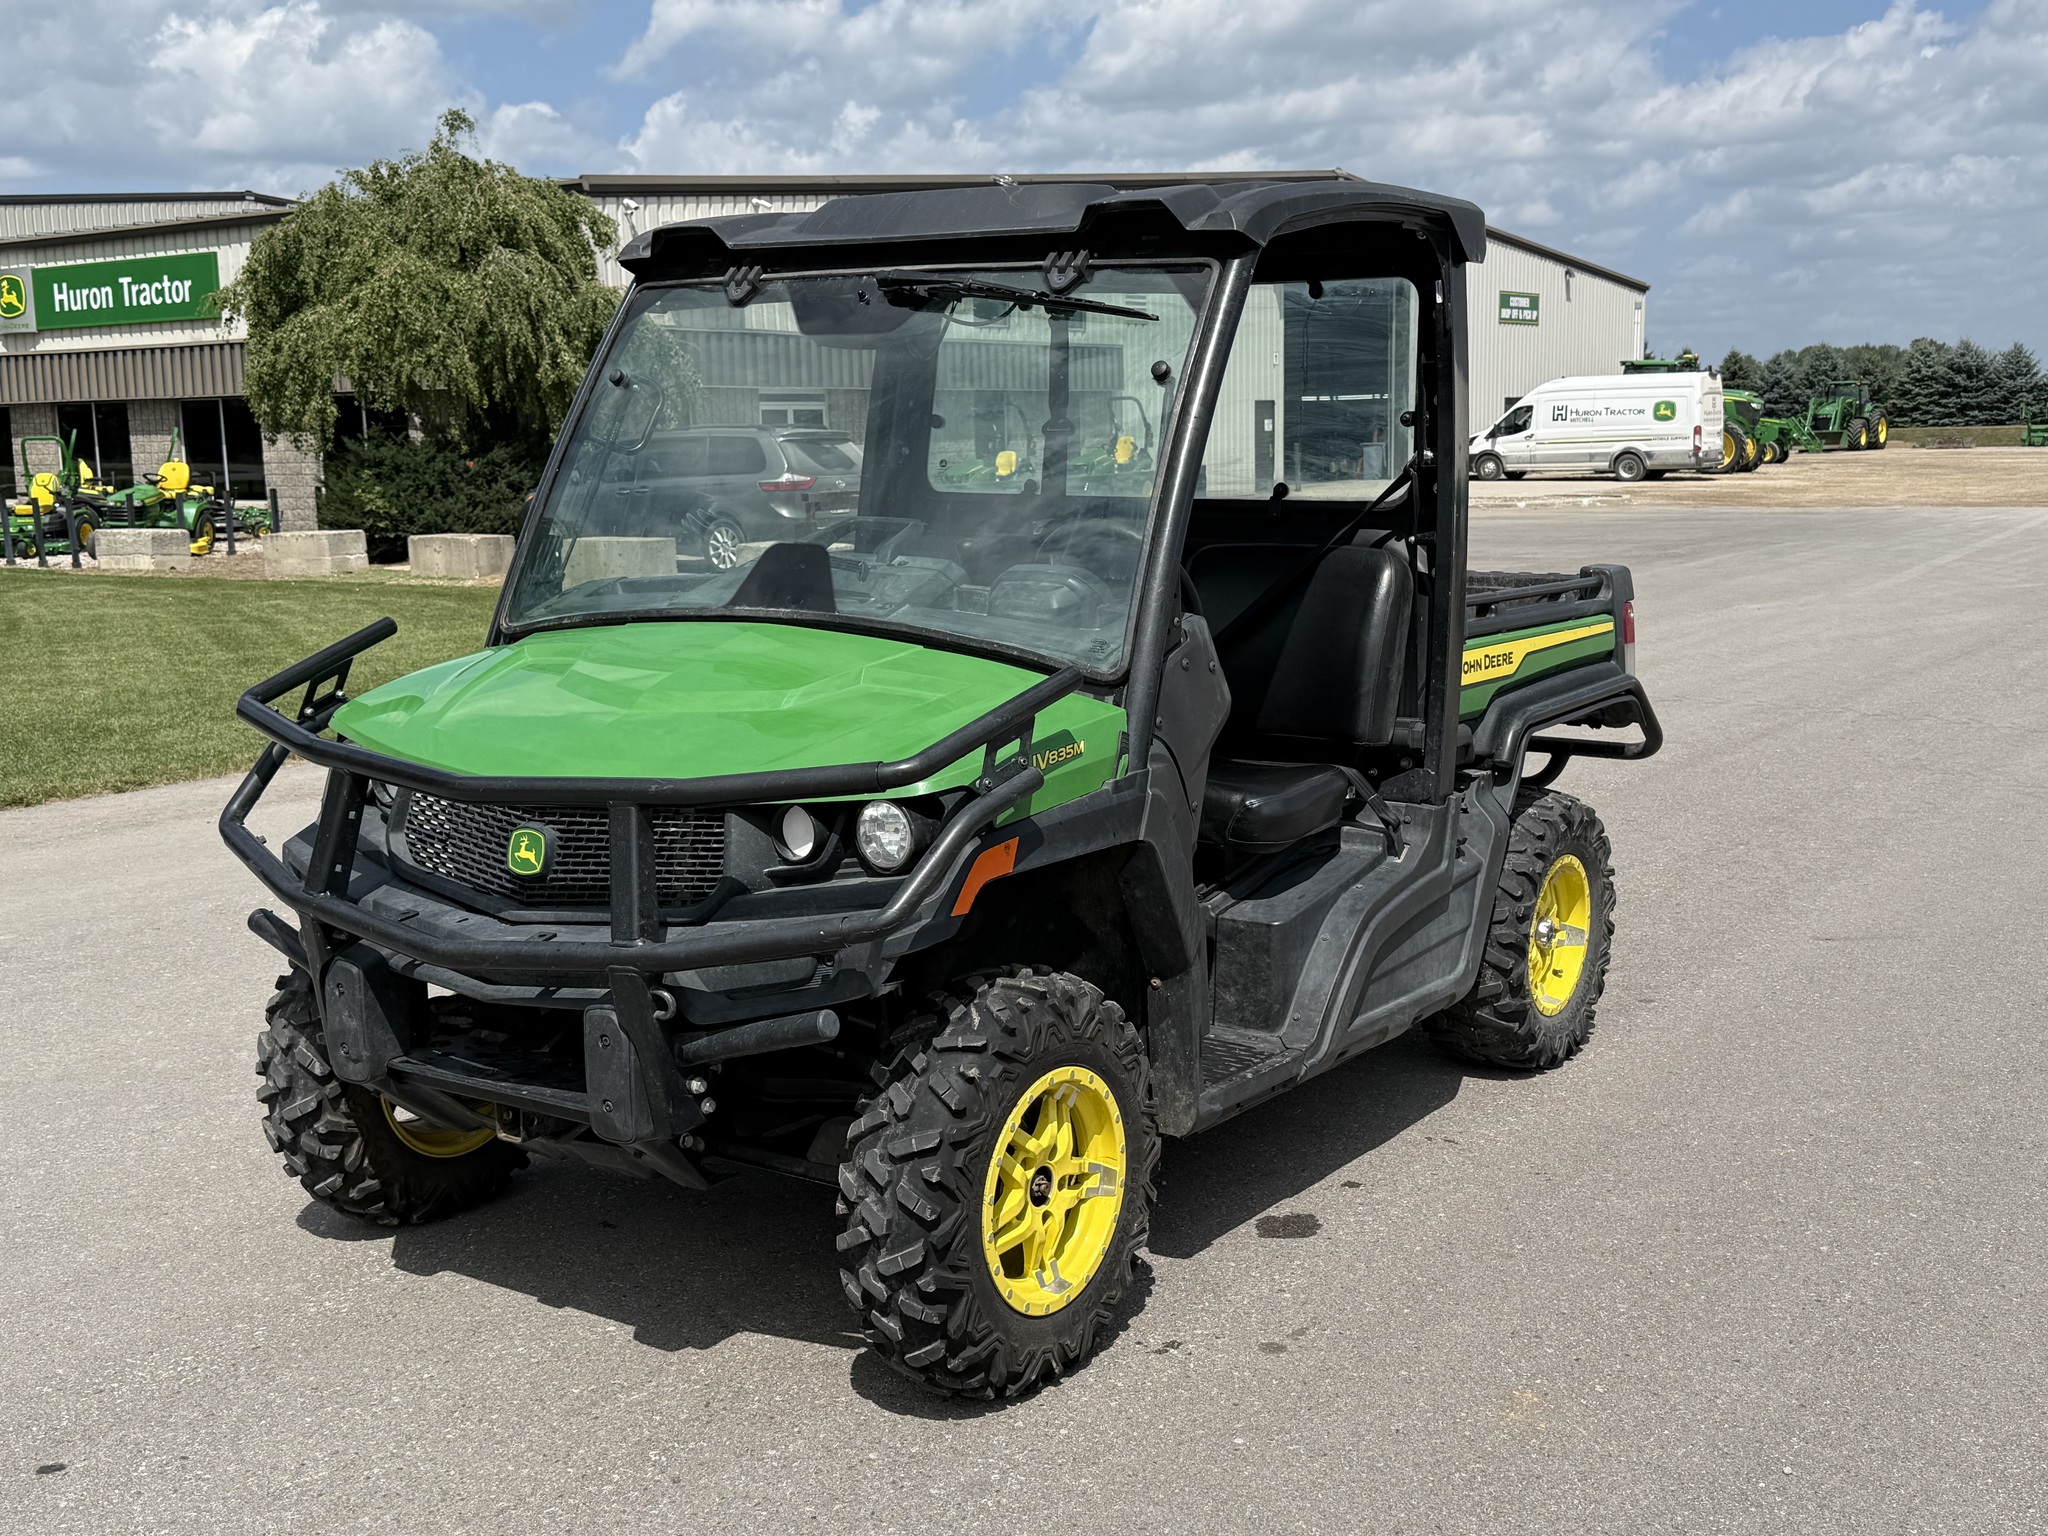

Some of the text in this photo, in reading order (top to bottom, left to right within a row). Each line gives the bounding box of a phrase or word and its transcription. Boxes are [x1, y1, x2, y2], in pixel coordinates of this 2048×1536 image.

[53, 274, 192, 312] Huron Tractor
[1570, 407, 1645, 417] HURON TRACTOR
[1463, 651, 1514, 675] OHN DEERE
